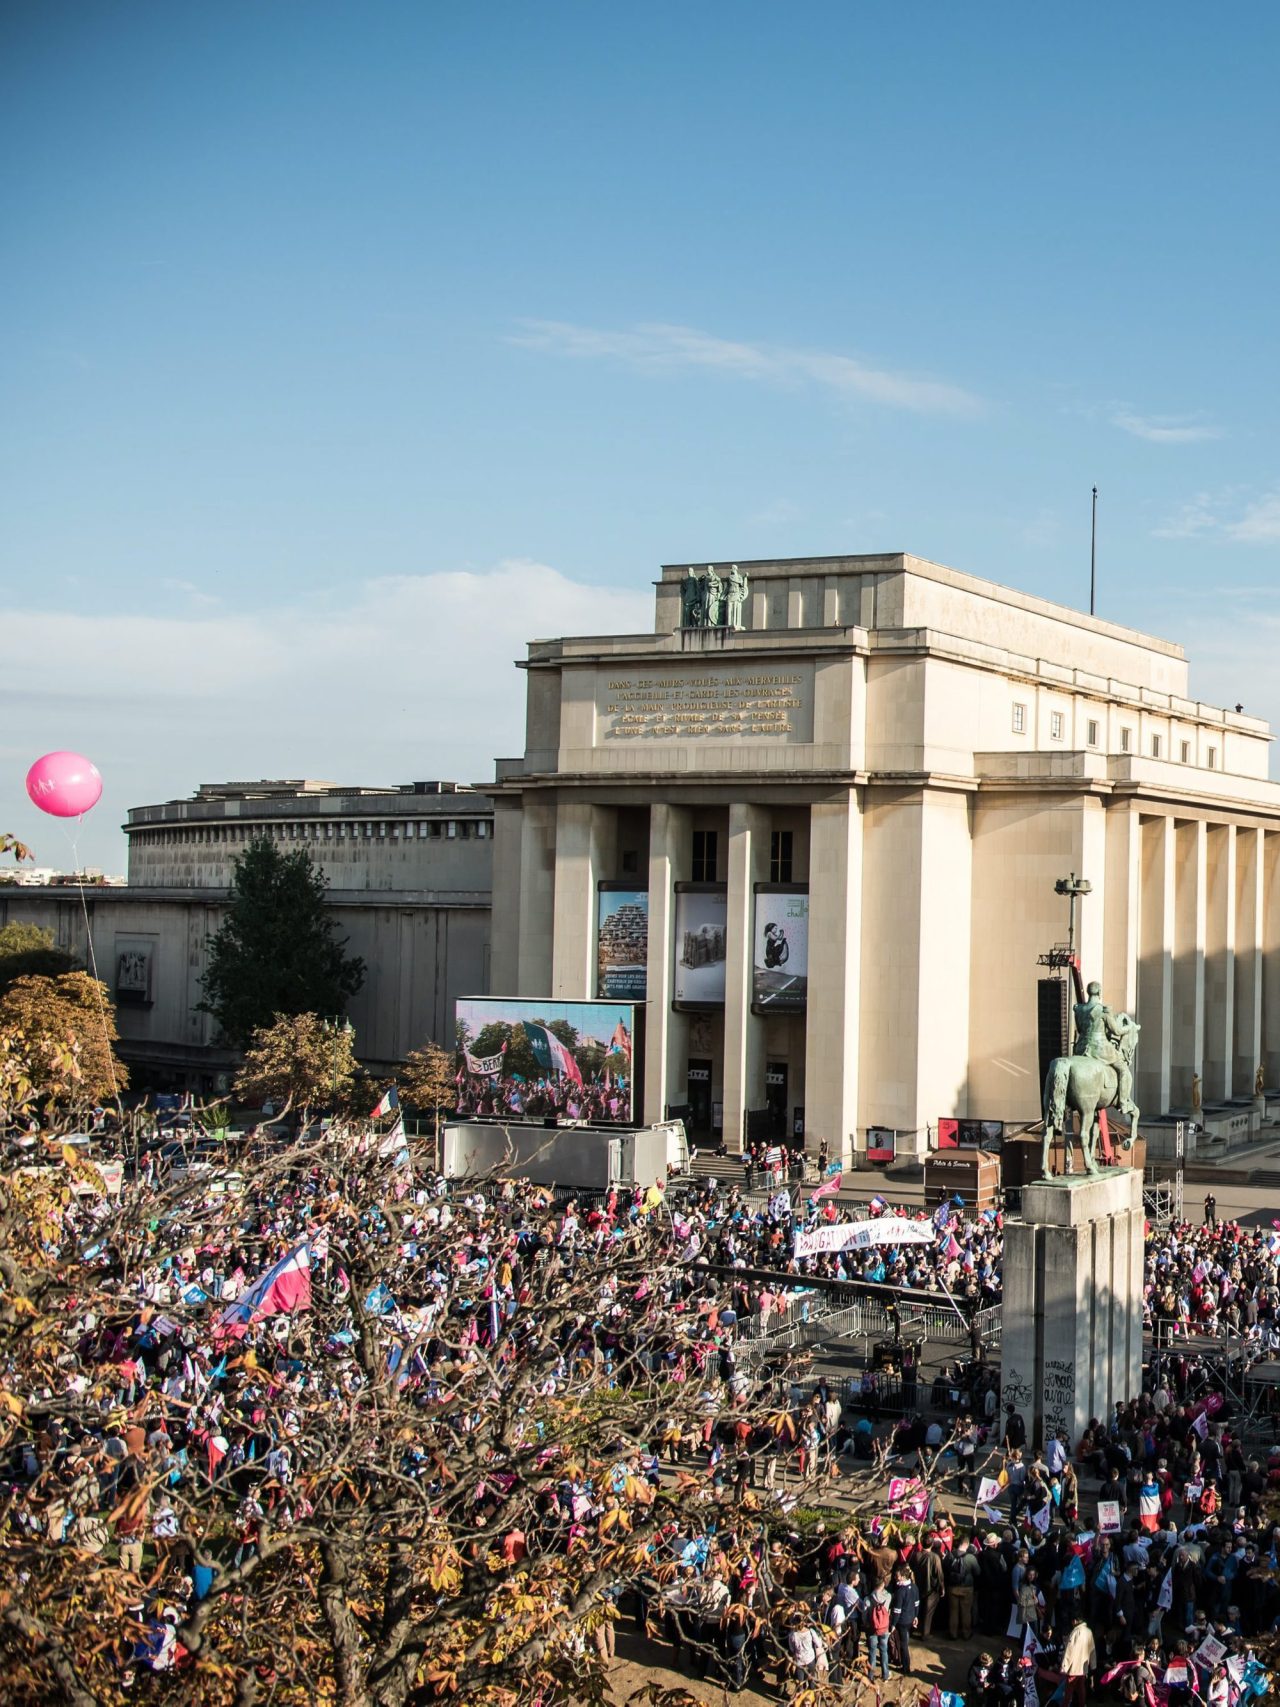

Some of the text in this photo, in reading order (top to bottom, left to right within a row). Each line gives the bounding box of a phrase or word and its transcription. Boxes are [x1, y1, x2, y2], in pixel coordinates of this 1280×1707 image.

[608, 681, 631, 690] DANS
[659, 679, 684, 688] MURS
[748, 675, 802, 685] MERVEILLES
[607, 703, 619, 712] DE
[641, 703, 664, 712] MAIN
